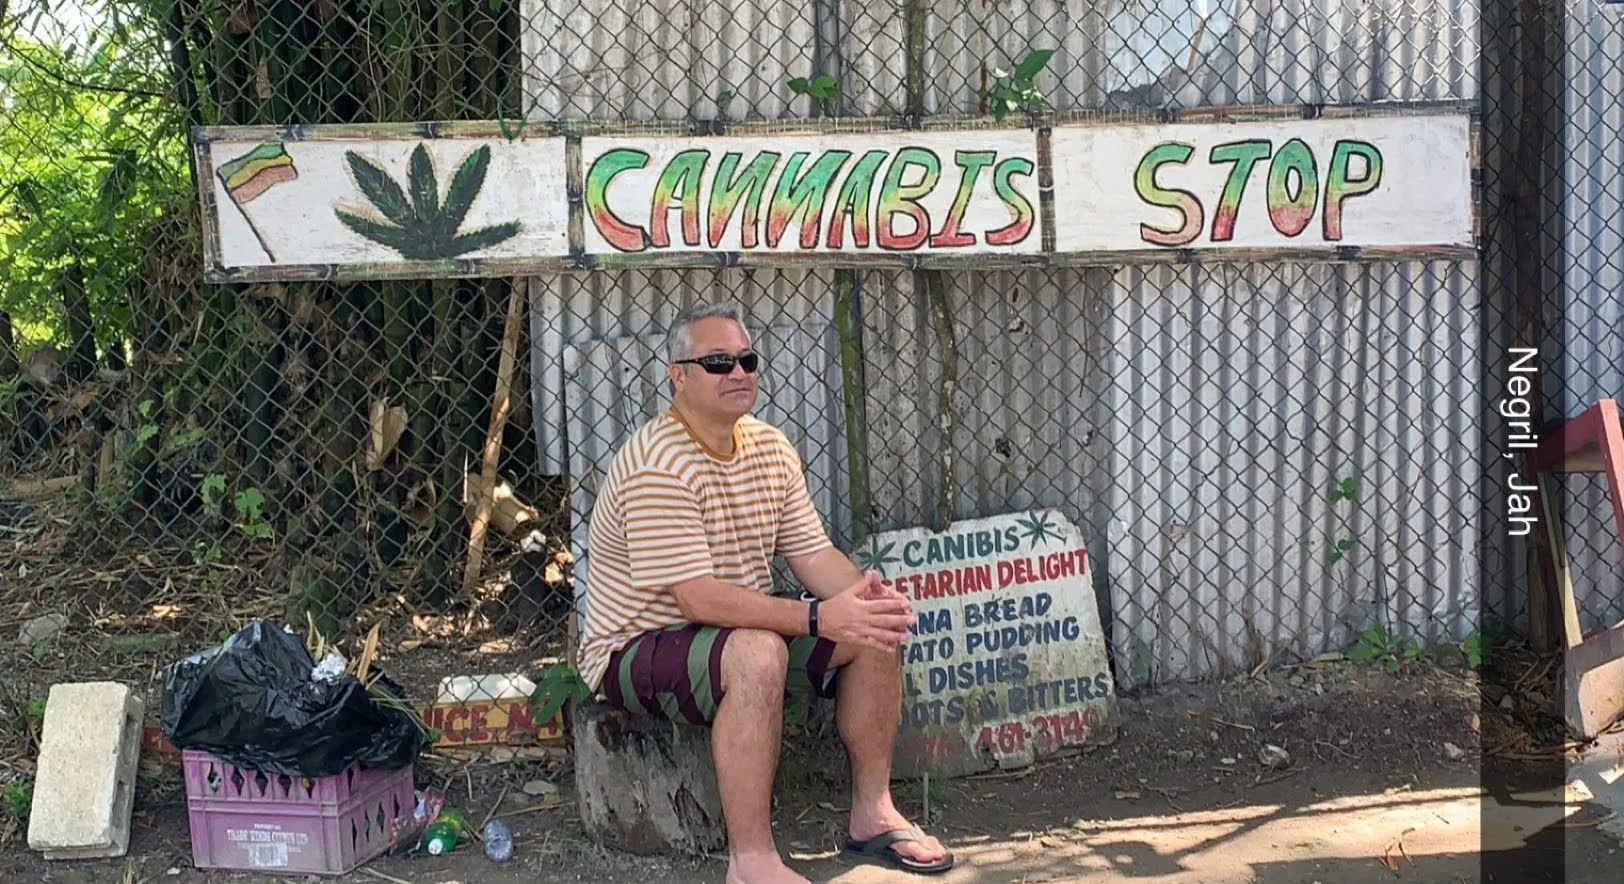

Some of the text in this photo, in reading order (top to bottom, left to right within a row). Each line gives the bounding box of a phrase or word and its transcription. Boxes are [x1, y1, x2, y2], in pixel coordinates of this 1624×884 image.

[585, 137, 1384, 252] CANNABIS STOP
[902, 525, 1021, 567] CANIBIS
[881, 548, 1088, 601] ETARIAN DELIGHT
[964, 592, 1053, 628] BREAD
[966, 616, 1080, 654] PUDDING
[929, 653, 1029, 694] DISHES
[1007, 672, 1108, 715] BITTERS
